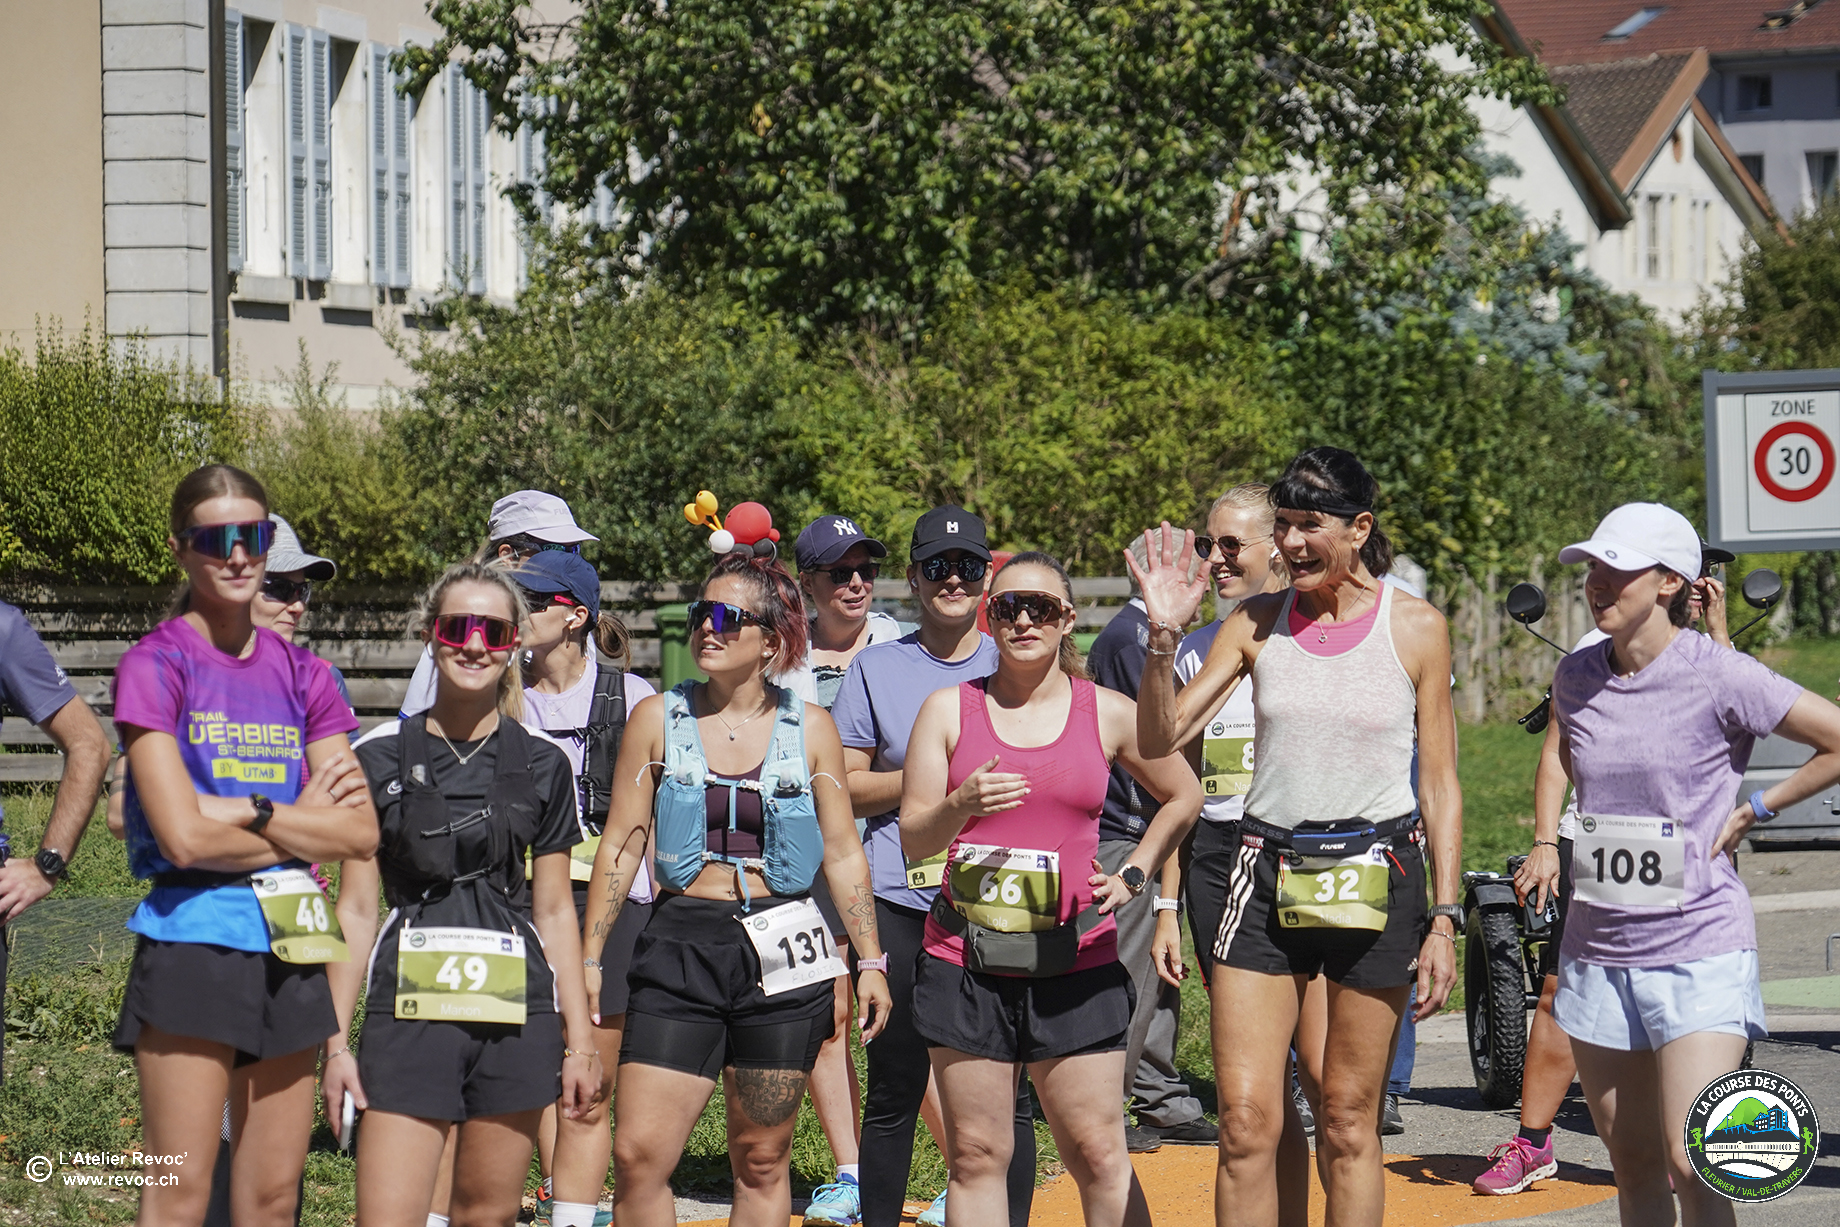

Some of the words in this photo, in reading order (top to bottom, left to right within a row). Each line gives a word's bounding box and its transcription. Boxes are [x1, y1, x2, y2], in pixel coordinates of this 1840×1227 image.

[1771, 399, 1816, 416] ZONE
[1779, 447, 1810, 476] 30
[188, 711, 229, 723] TRAIL
[217, 744, 302, 760] ST-BERNARD
[219, 762, 233, 774] BY
[243, 766, 275, 779] UTMB
[1591, 847, 1663, 887] 108
[979, 871, 1022, 905] 66
[1314, 869, 1360, 903] 32
[295, 896, 329, 932] 48
[775, 907, 794, 917] COURSE
[986, 914, 1008, 928] Lola
[1320, 913, 1352, 925] Nadia
[777, 926, 829, 970] 137
[435, 955, 488, 991] 49
[791, 963, 836, 984] ELODIE
[440, 1003, 481, 1016] Manon
